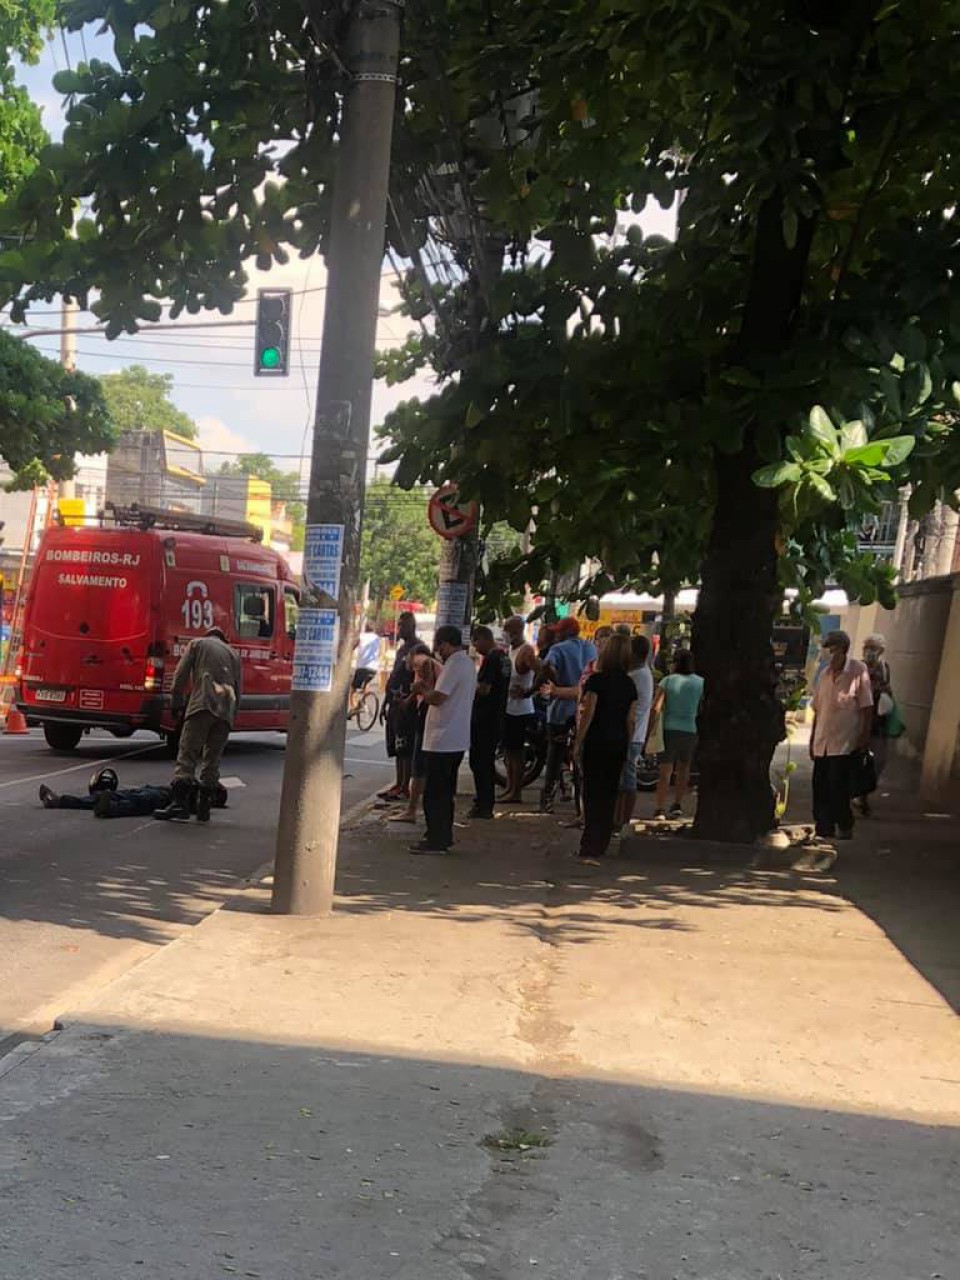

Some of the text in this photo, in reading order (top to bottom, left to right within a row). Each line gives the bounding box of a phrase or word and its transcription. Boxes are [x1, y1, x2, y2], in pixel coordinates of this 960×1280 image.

[46, 550, 140, 565] BOMBEIROS-RJ
[58, 573, 127, 588] SALVAMENTO
[182, 599, 214, 629] 193
